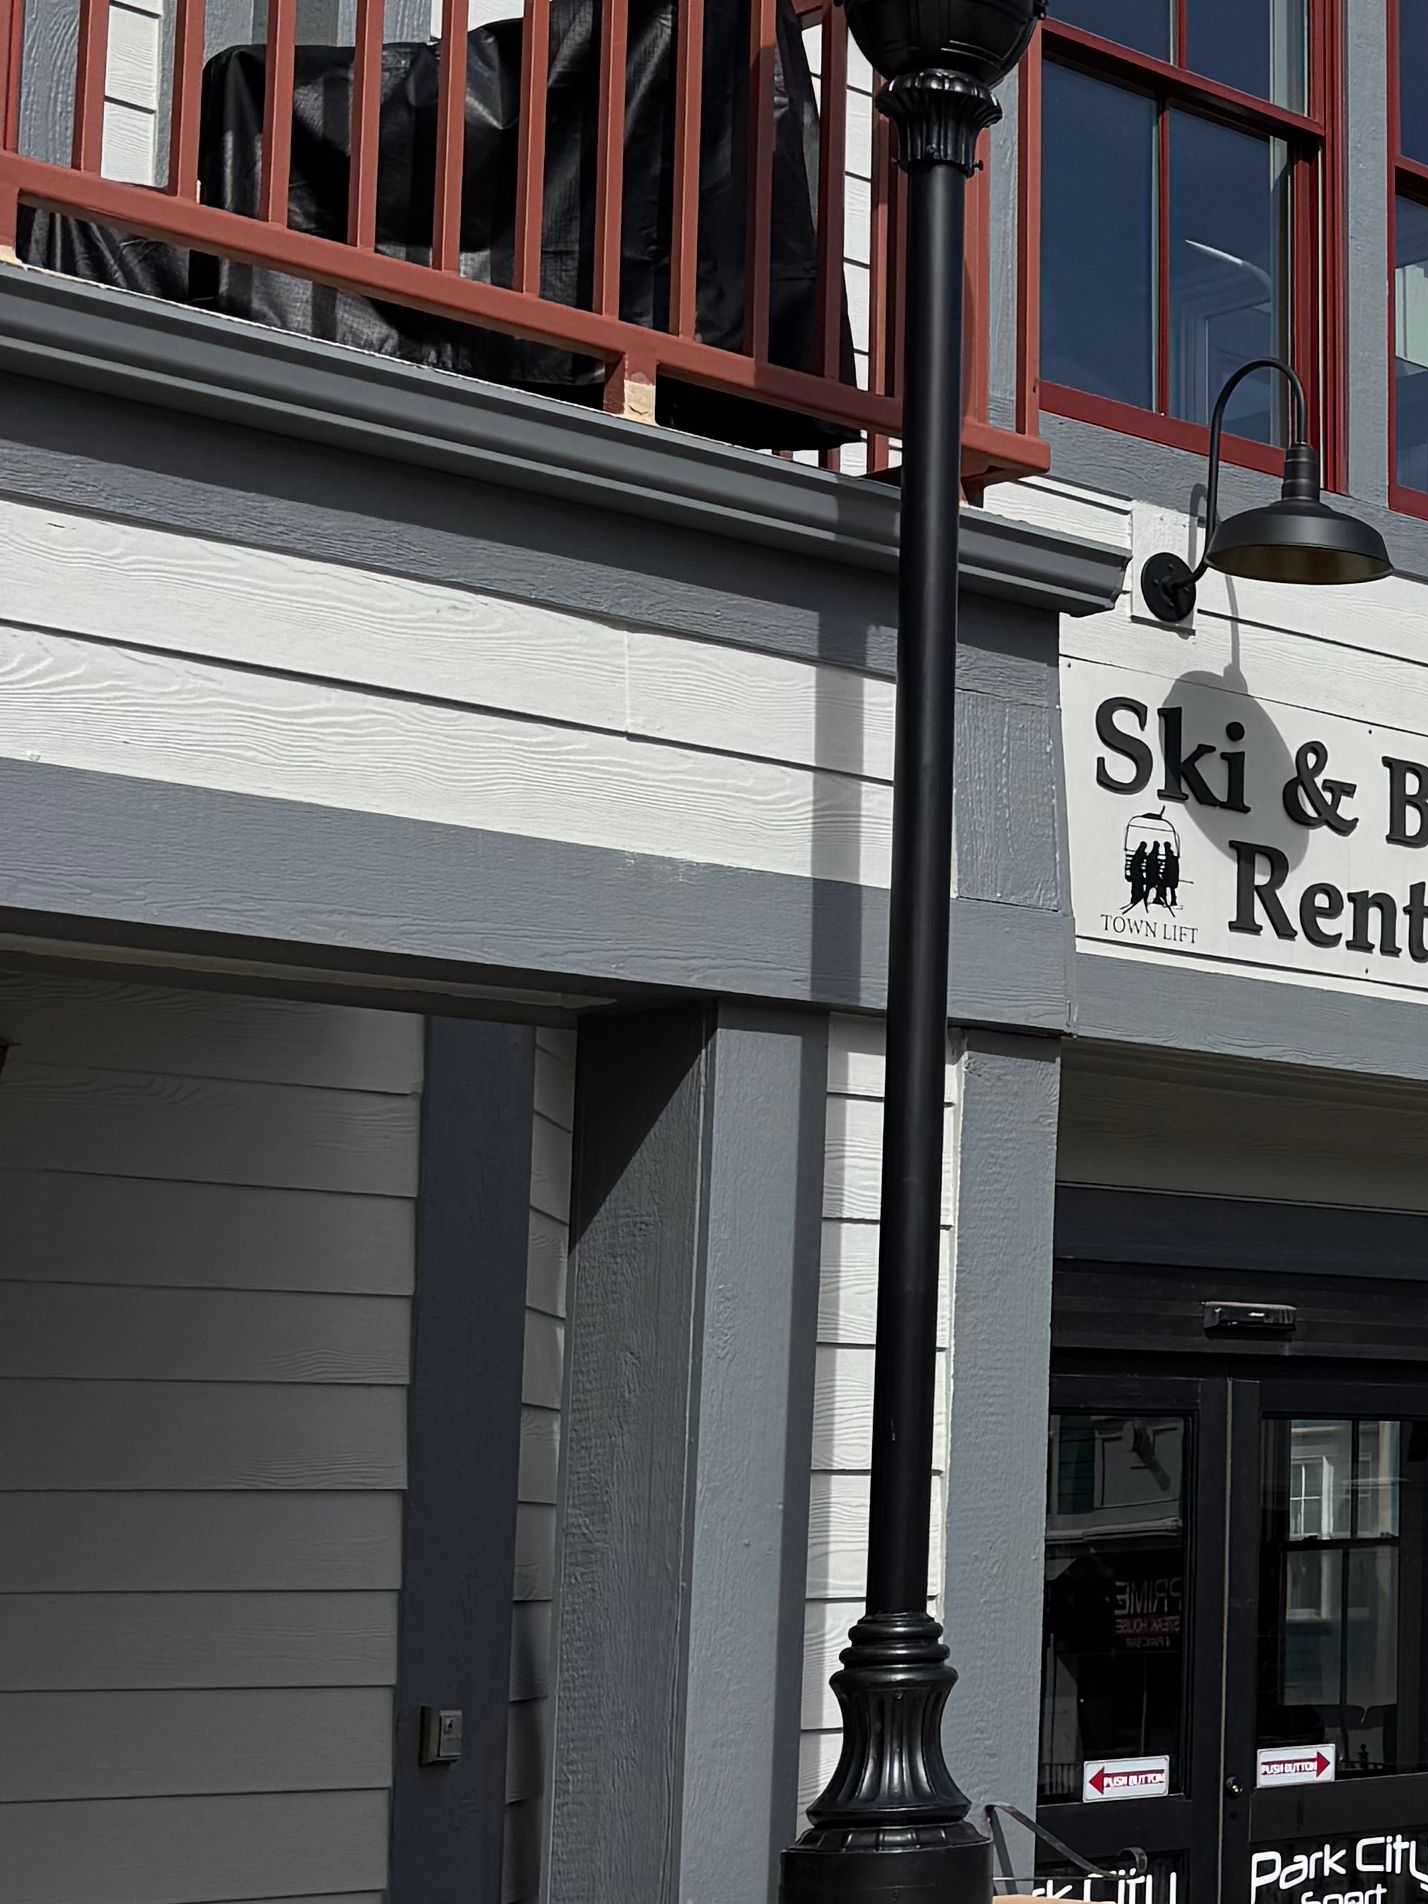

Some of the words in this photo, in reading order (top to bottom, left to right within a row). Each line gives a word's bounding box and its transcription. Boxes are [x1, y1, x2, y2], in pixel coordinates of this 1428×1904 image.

[1094, 696, 1252, 814] Ski
[1282, 739, 1359, 837] &
[1100, 913, 1158, 939] TOWN
[1163, 923, 1199, 945] LIFT
